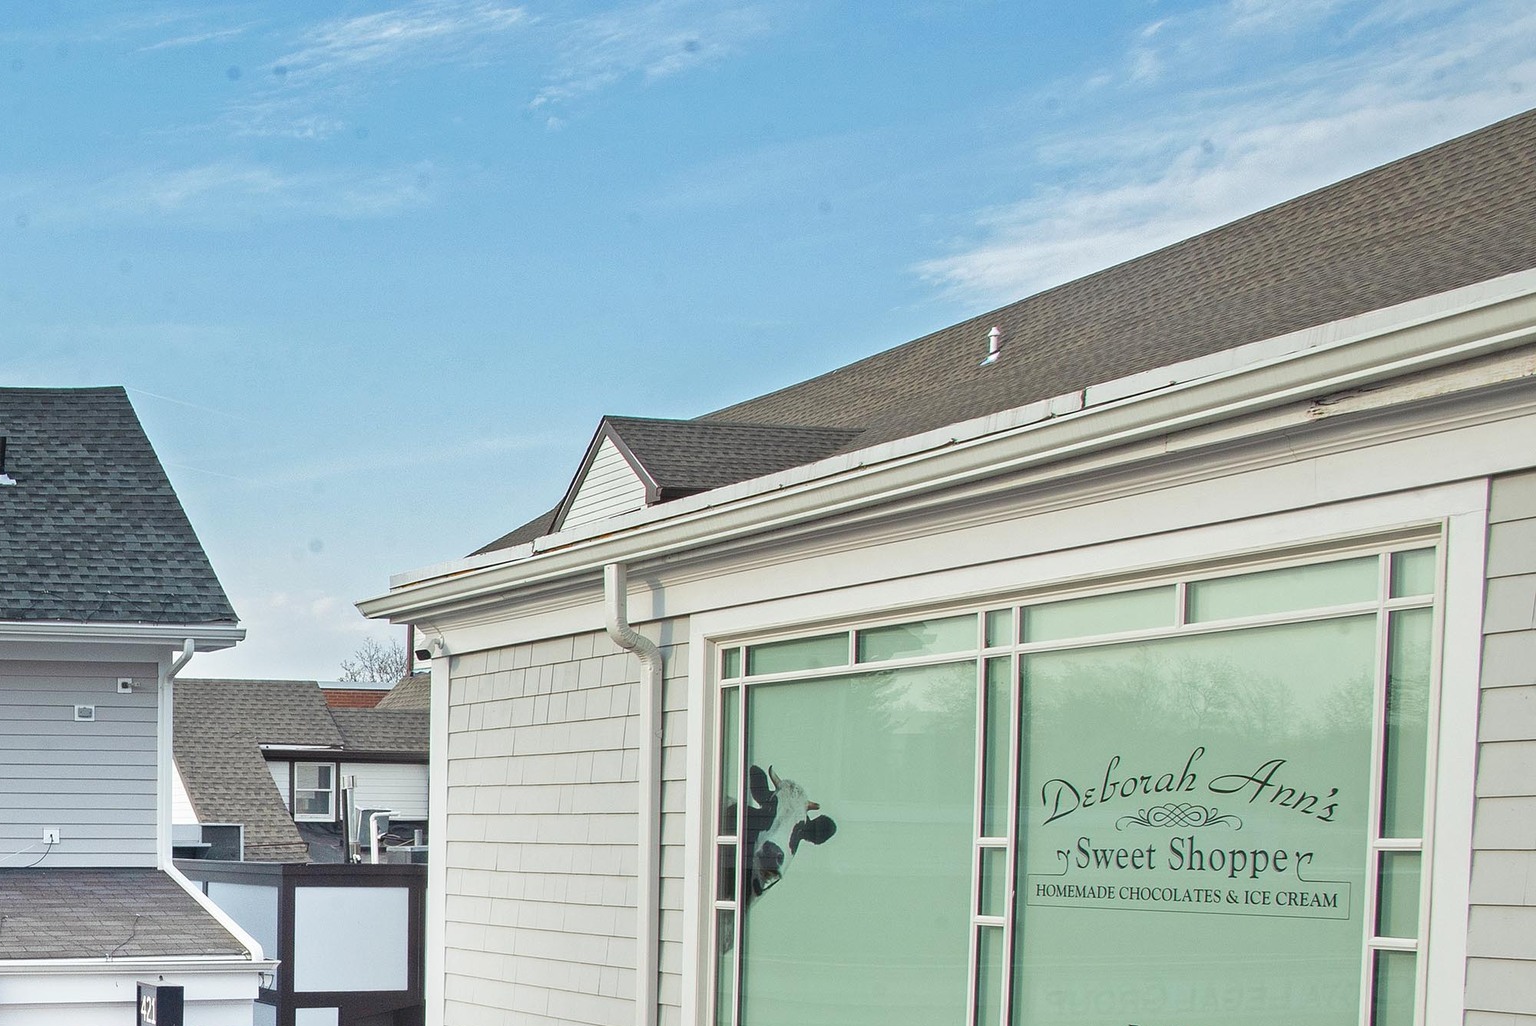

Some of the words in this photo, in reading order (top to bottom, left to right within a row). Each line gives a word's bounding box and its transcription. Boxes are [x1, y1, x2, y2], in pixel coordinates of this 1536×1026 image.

[1041, 746, 1205, 826] Deborah
[1208, 759, 1340, 823] Ann's
[1075, 836, 1157, 871] Sweet
[1168, 835, 1289, 879] Shoppe
[1036, 883, 1115, 899] HOMEMADE
[1118, 886, 1221, 904] CHOCOLATES
[1226, 891, 1238, 905] &
[1244, 890, 1271, 906] ICE
[1275, 891, 1338, 908] CREAM
[140, 995, 156, 1025] 421
